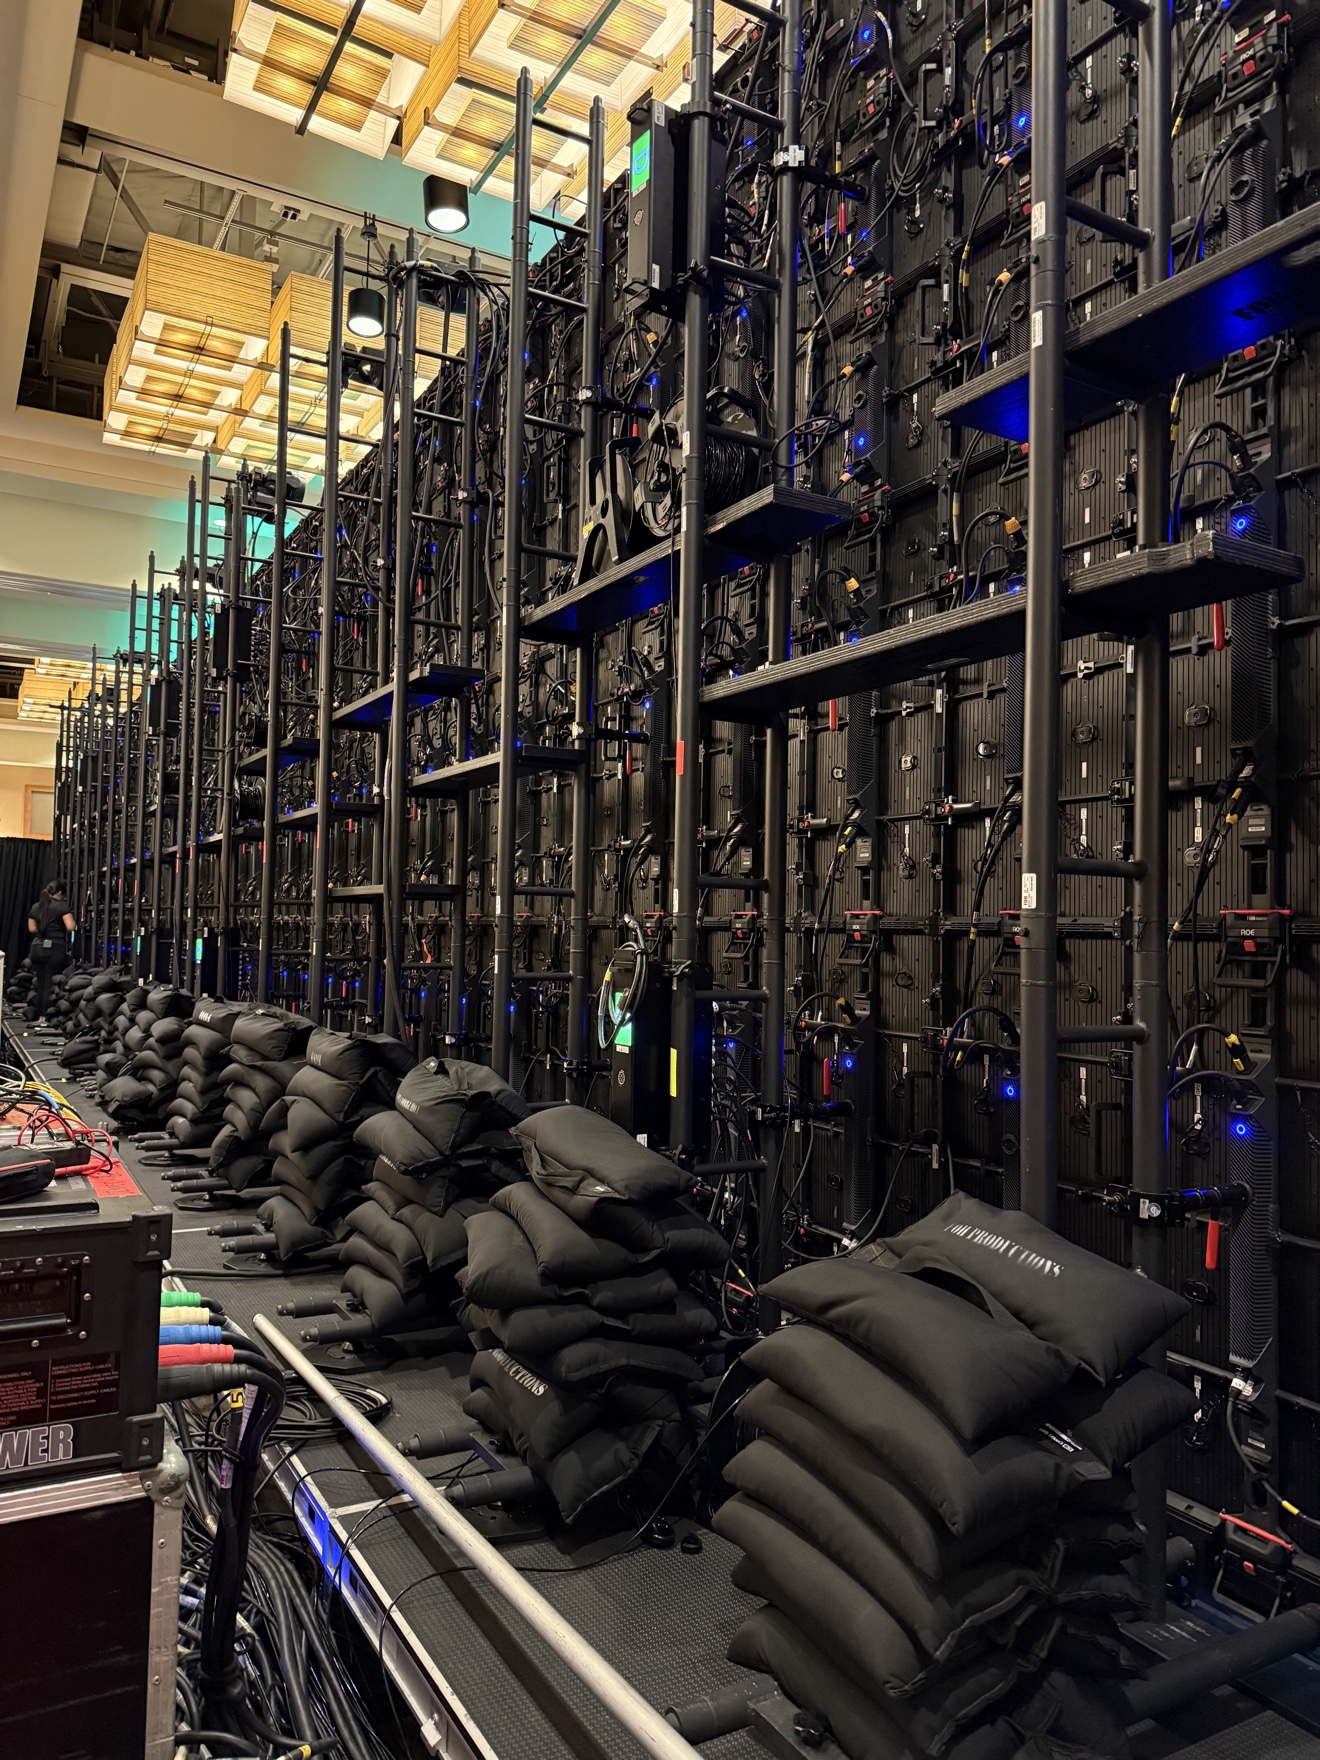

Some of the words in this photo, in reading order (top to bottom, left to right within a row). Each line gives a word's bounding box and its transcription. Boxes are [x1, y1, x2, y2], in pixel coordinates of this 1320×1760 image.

[966, 1228, 1064, 1278] PRODUCTIONS
[231, 1390, 244, 1404] 5
[0, 1424, 74, 1470] WER
